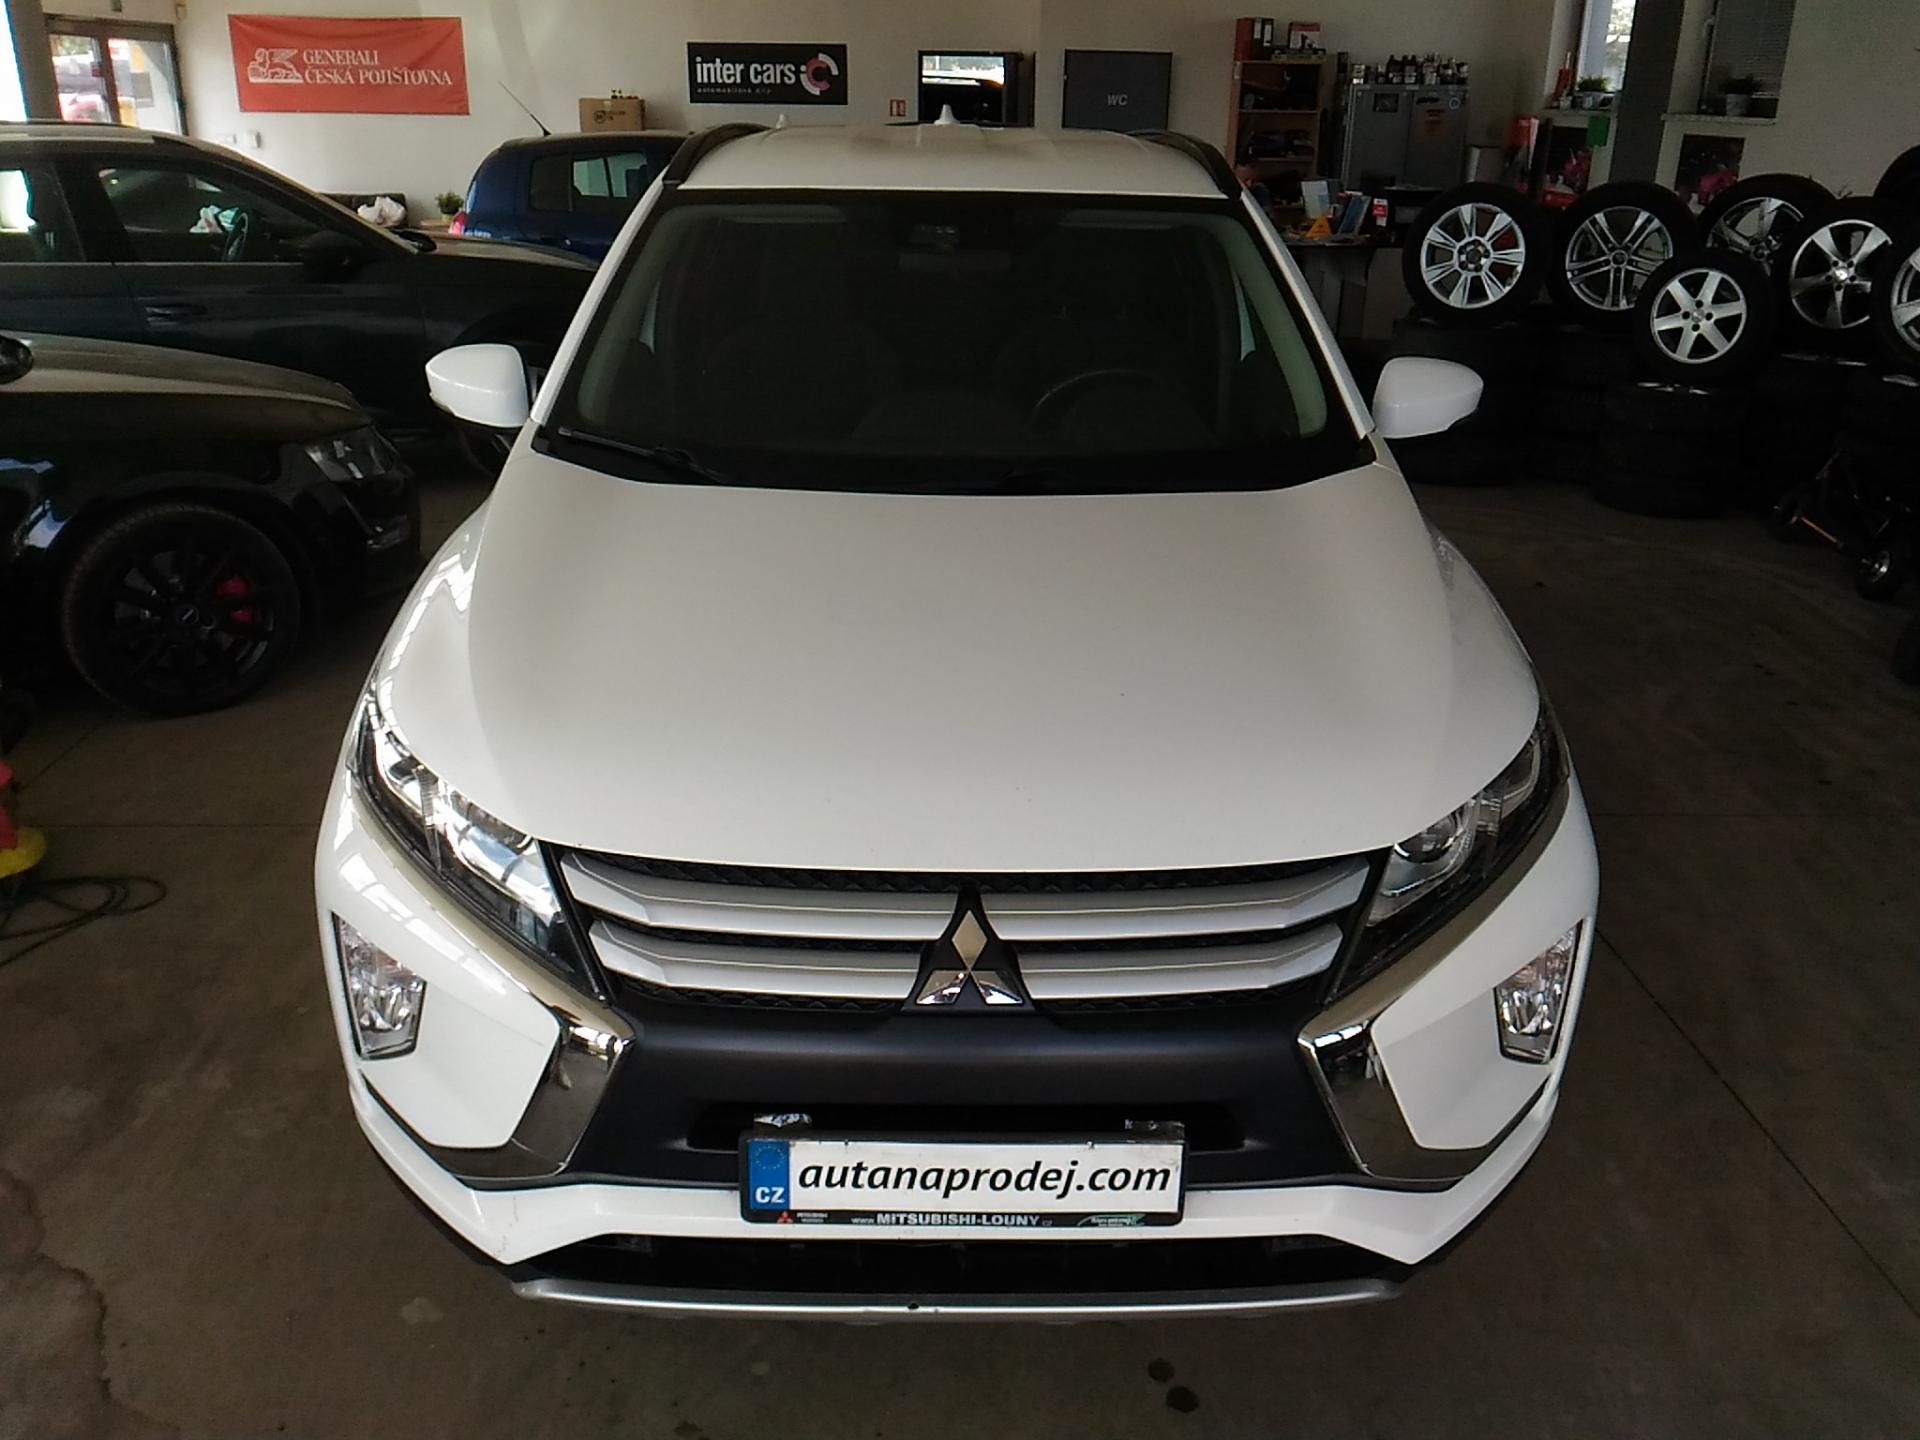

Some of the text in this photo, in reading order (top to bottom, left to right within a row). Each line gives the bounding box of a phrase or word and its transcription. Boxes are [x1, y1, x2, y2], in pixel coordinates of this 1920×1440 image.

[303, 49, 379, 65] GENERALI
[304, 65, 452, 86] ČESKÁ POJIŠŤOVNA
[695, 56, 796, 84] inter cars
[1107, 94, 1128, 106] WC
[799, 1160, 1171, 1199] autanaprodej.com
[755, 1186, 786, 1204] CZ
